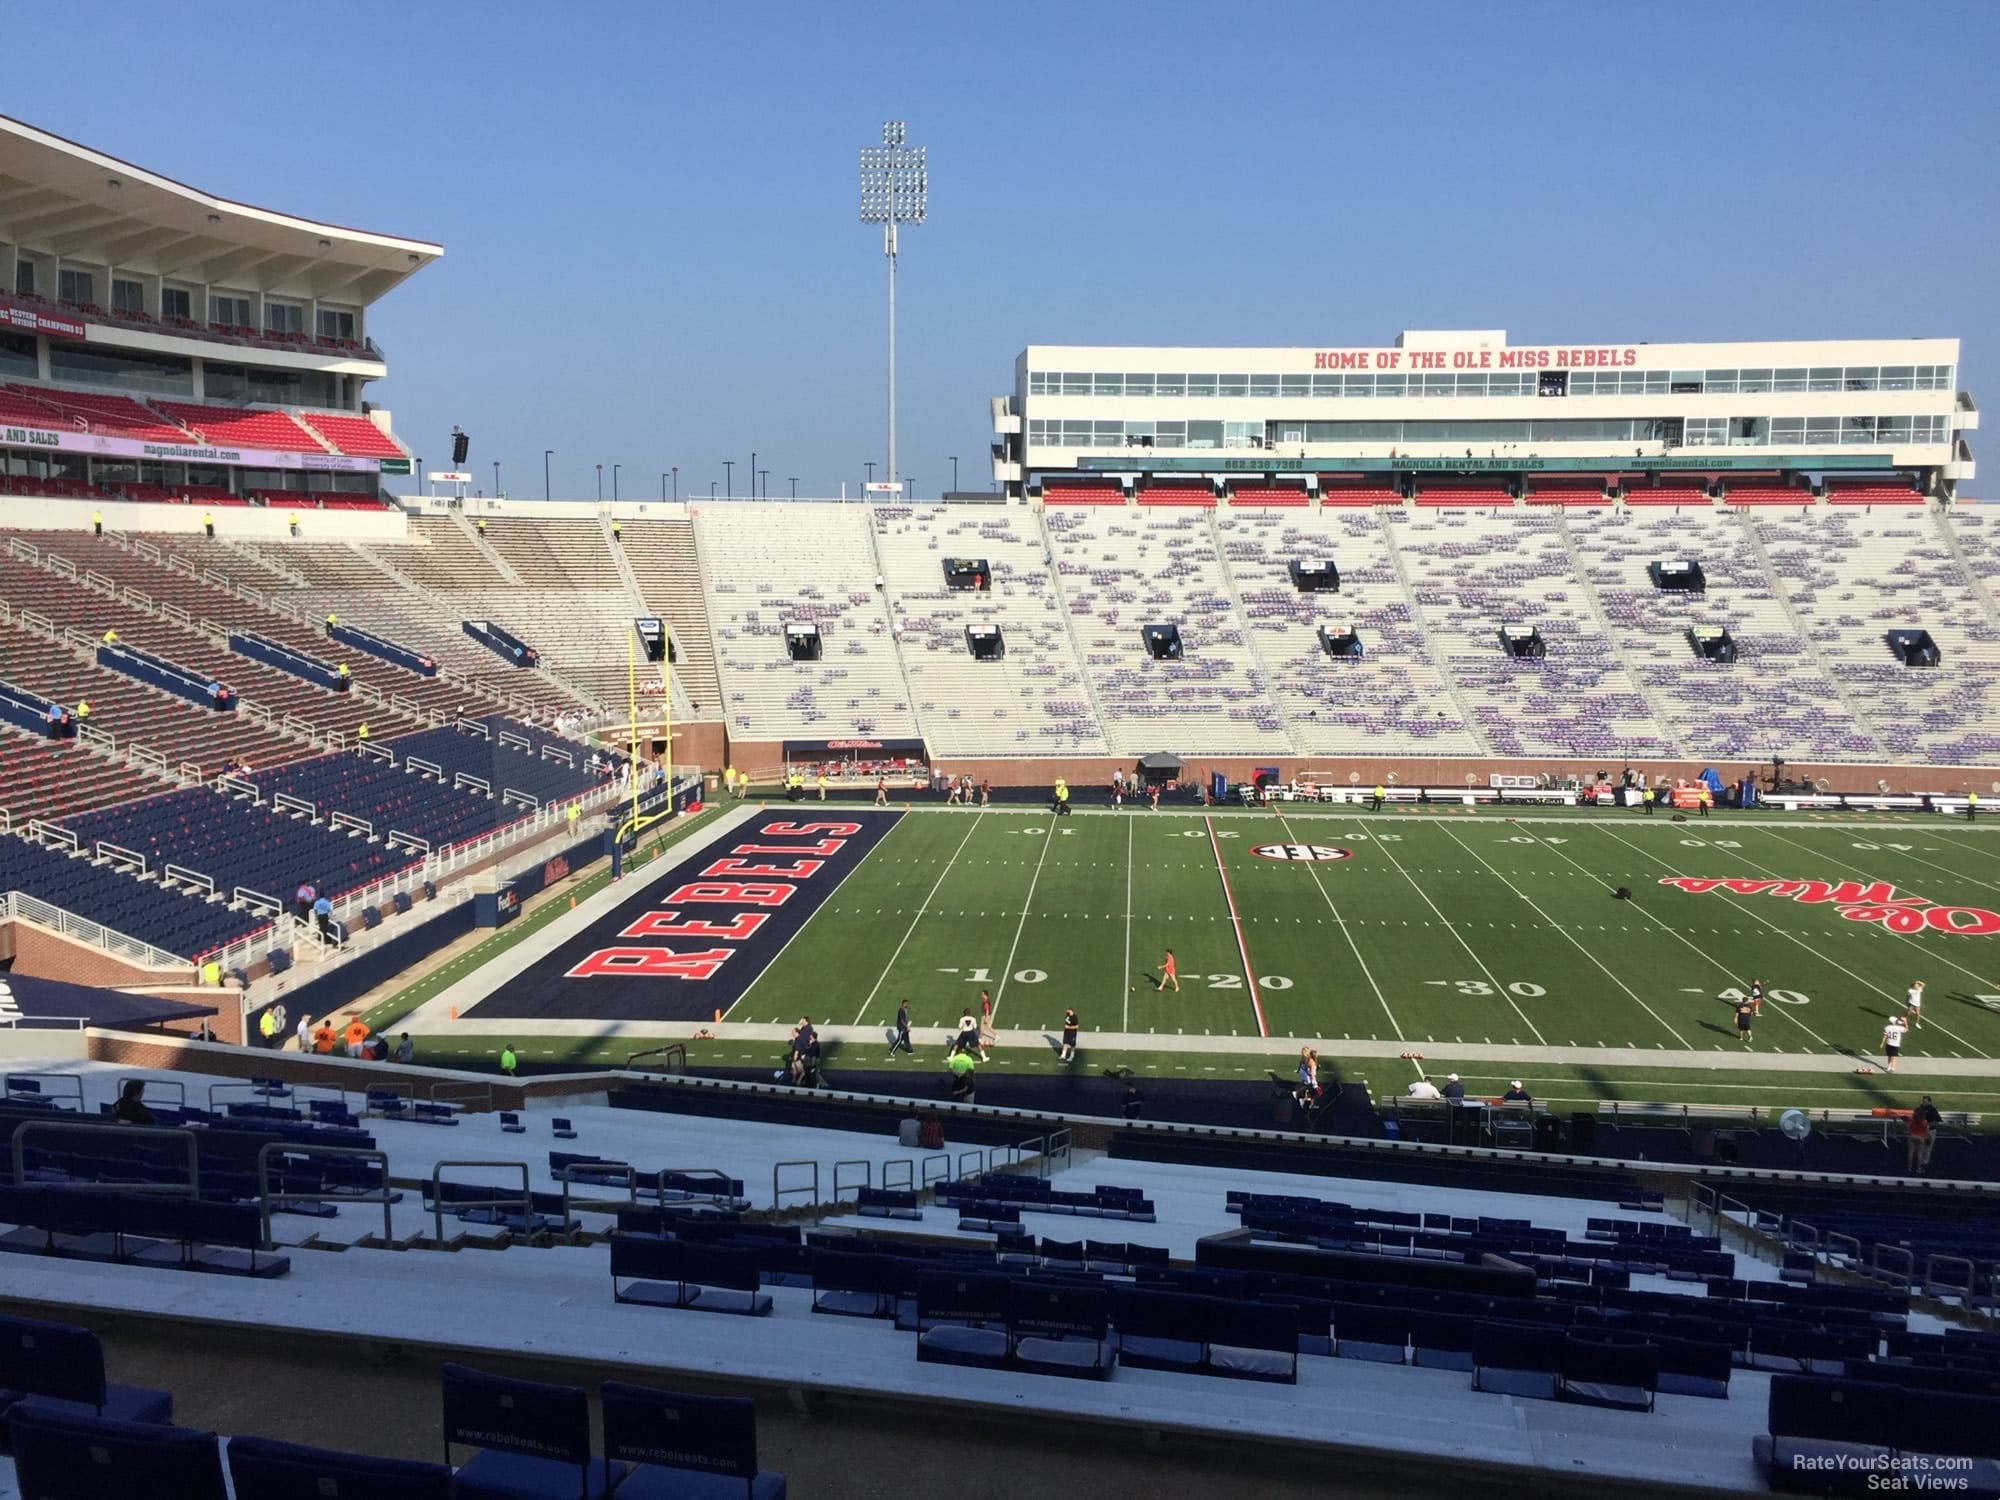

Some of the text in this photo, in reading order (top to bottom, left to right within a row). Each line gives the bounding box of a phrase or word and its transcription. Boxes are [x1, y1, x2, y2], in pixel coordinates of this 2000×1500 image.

[38, 318, 74, 333] CHAMPIONS
[1314, 349, 1637, 369] HOME OF THE OLE MISS REBELS
[6, 428, 26, 442] AND
[29, 431, 59, 446] SALES
[143, 445, 241, 460] magnoliarental.com
[1391, 460, 1545, 469] MAGNOLIA RENTAL AND SALES
[1658, 876, 1933, 904] Miss
[563, 821, 864, 980] REBELS
[456, 1427, 571, 1457] www.rebelseats.com
[618, 1443, 738, 1468] www.rebelseats.com
